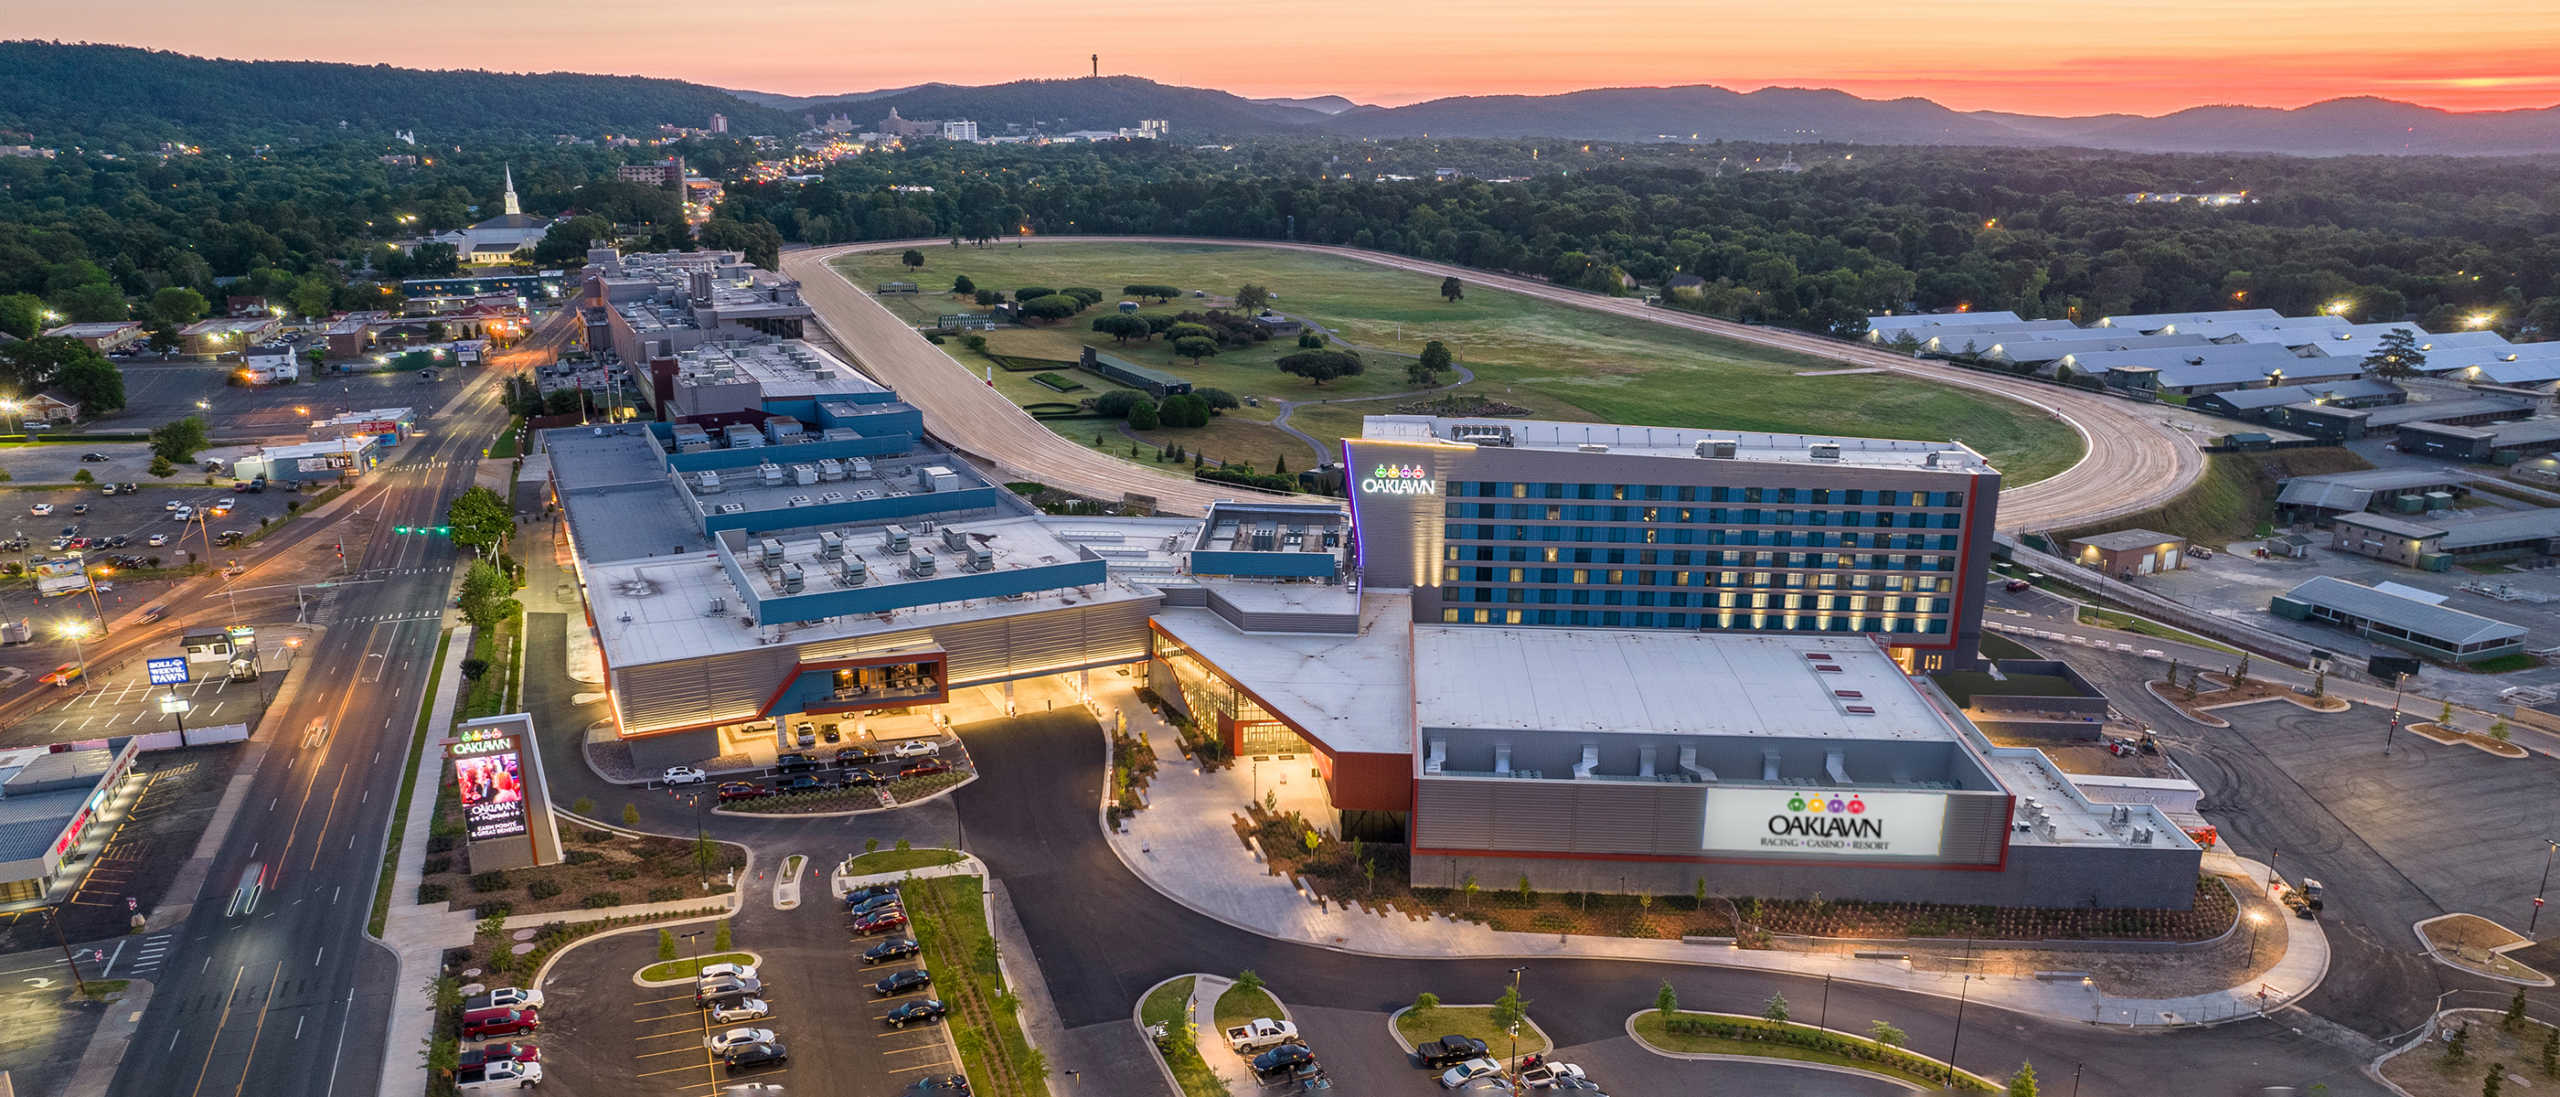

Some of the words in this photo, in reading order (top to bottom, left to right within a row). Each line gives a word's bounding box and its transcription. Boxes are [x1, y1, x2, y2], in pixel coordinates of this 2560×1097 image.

[1362, 479, 1434, 494] OAKLAWN
[151, 673, 186, 683] PAWN
[454, 739, 510, 754] OAKLAWN
[472, 802, 515, 814] OAKLAWN
[1769, 815, 1882, 838] OAKLAWN
[1761, 838, 1798, 848] RACING
[1806, 839, 1845, 848] CASINO
[1852, 840, 1890, 850] RESORT
